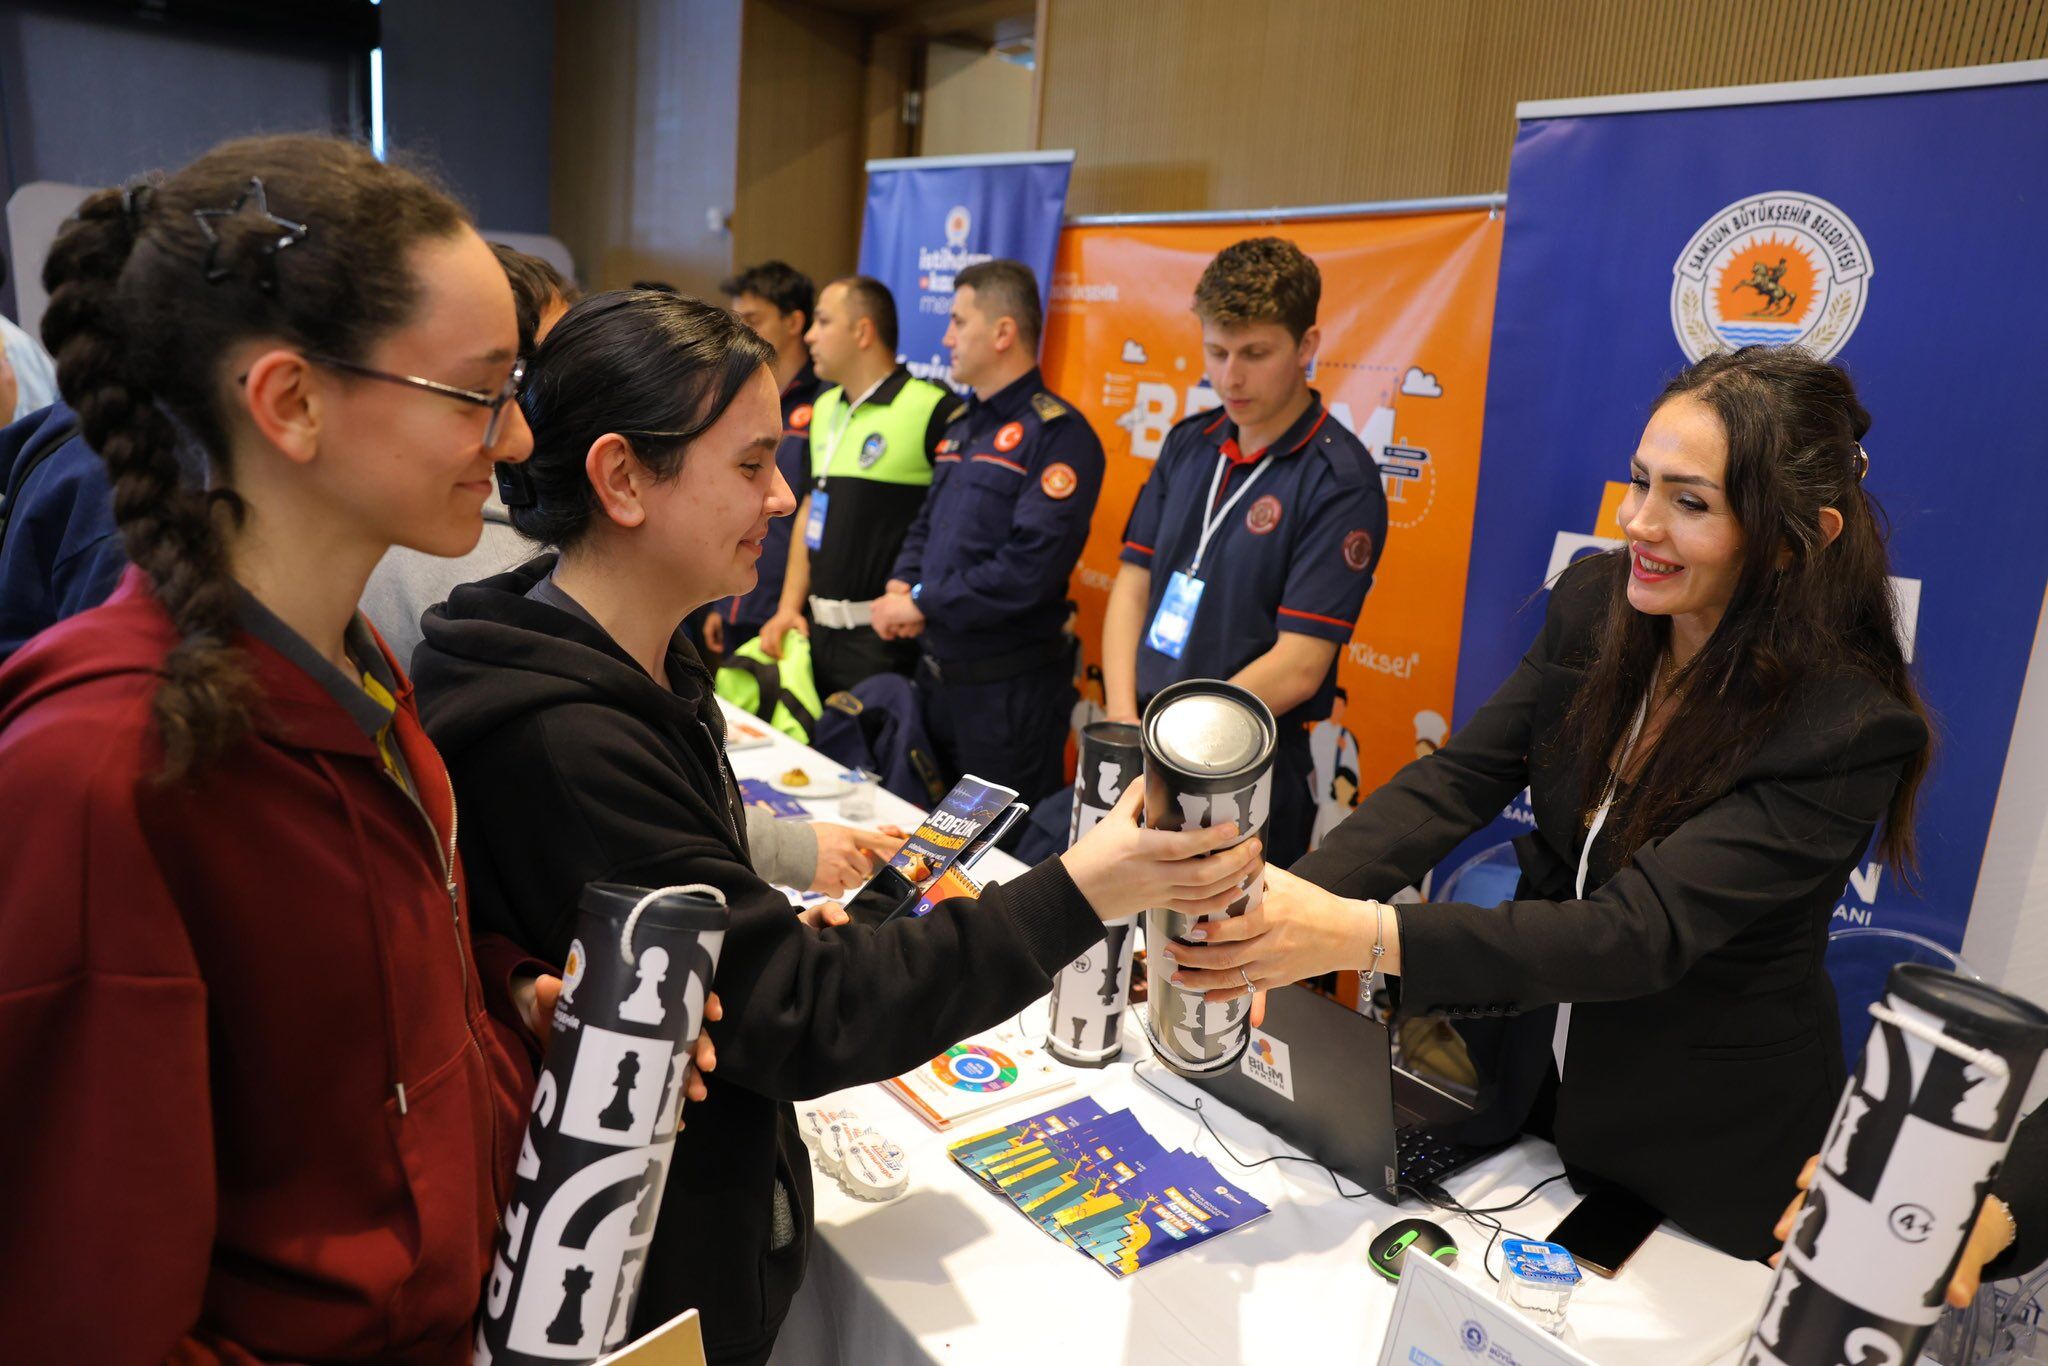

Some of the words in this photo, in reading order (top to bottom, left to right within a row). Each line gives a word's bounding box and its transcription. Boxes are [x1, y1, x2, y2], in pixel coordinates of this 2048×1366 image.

[1689, 223, 1731, 270] SAMSUN
[1732, 201, 1811, 232] BÜYÜKŞEHİR
[1810, 214, 1862, 272] BELEDİYESİ
[925, 810, 981, 838] JEOFİZİK
[1250, 1066, 1285, 1090] SAMSUN
[1166, 1200, 1210, 1234] İSTİHDAM
